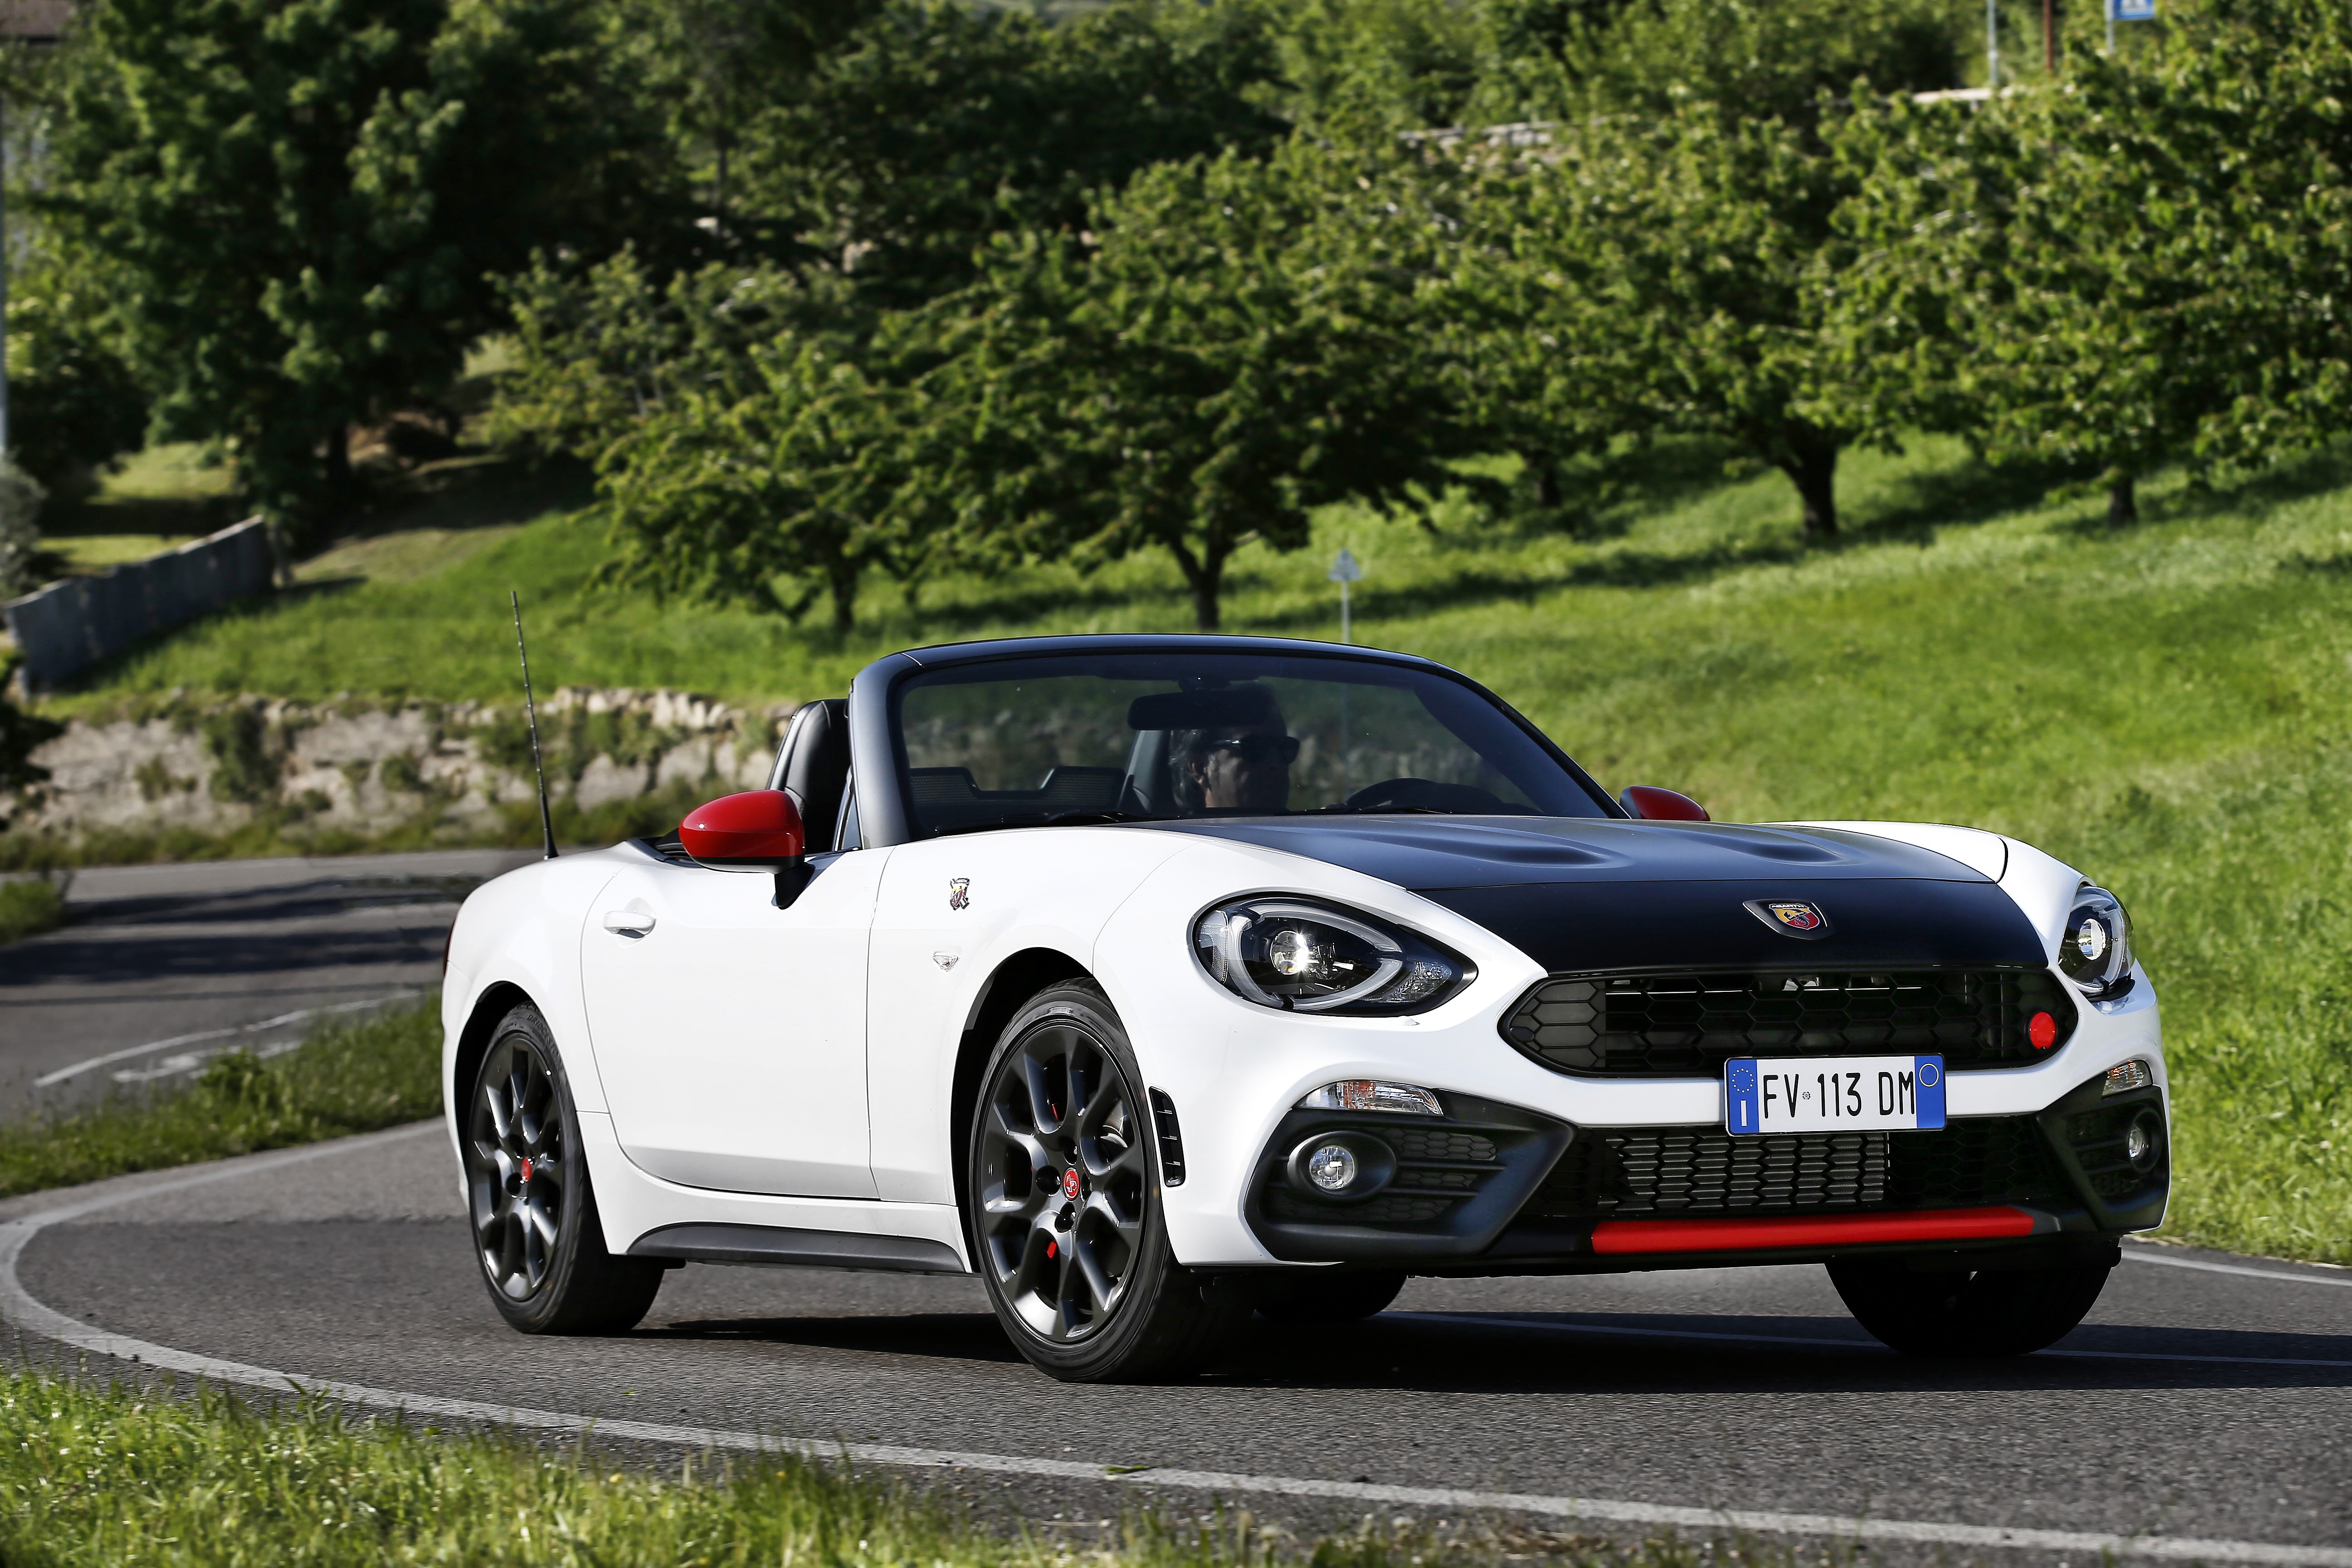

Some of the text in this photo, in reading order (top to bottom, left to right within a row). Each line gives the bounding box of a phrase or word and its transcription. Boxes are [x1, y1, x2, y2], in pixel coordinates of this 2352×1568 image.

[1740, 1100, 1747, 1127] I
[1763, 1071, 1915, 1119] FV 113 DM
